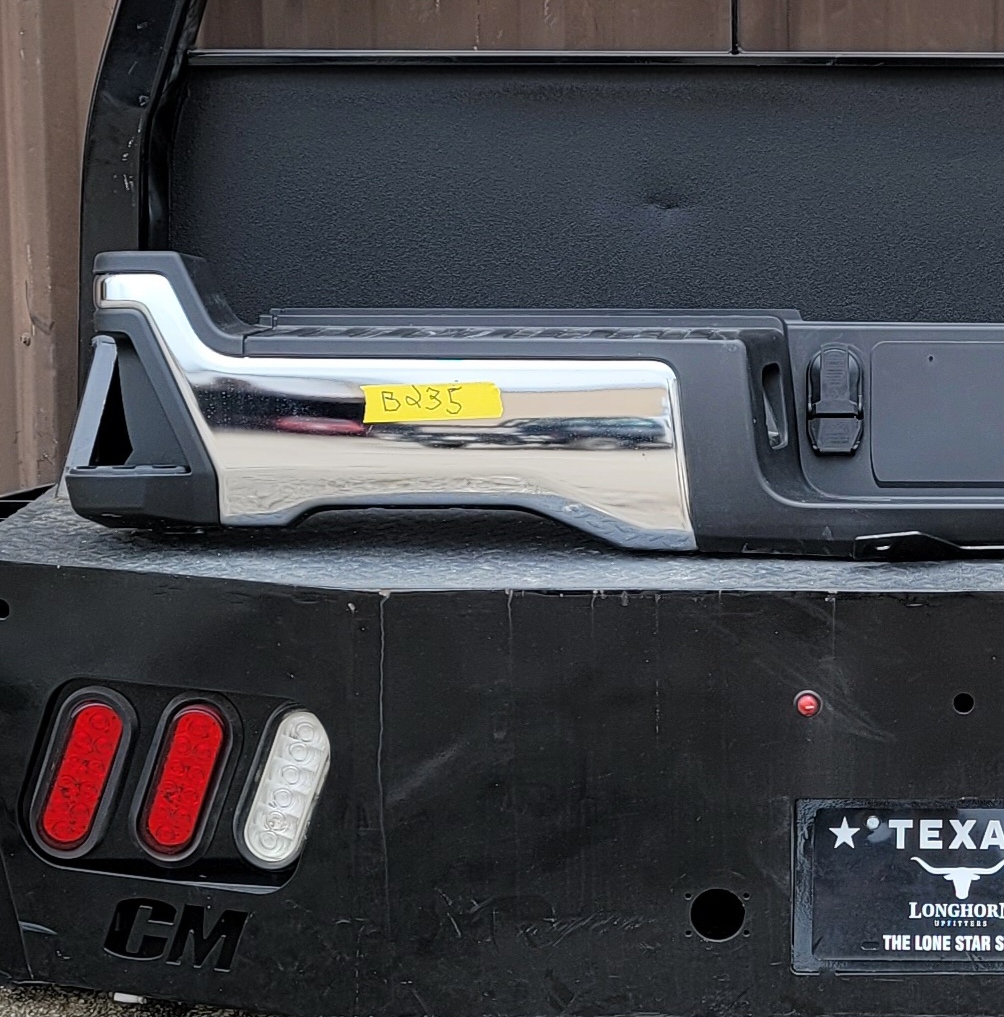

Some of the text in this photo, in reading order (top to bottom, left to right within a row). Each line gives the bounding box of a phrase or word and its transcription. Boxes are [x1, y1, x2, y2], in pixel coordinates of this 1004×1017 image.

[933, 919, 988, 928] UPFITTERS
[882, 934, 911, 951] THE
[914, 934, 952, 952] LONE
[954, 934, 991, 952] STAR
